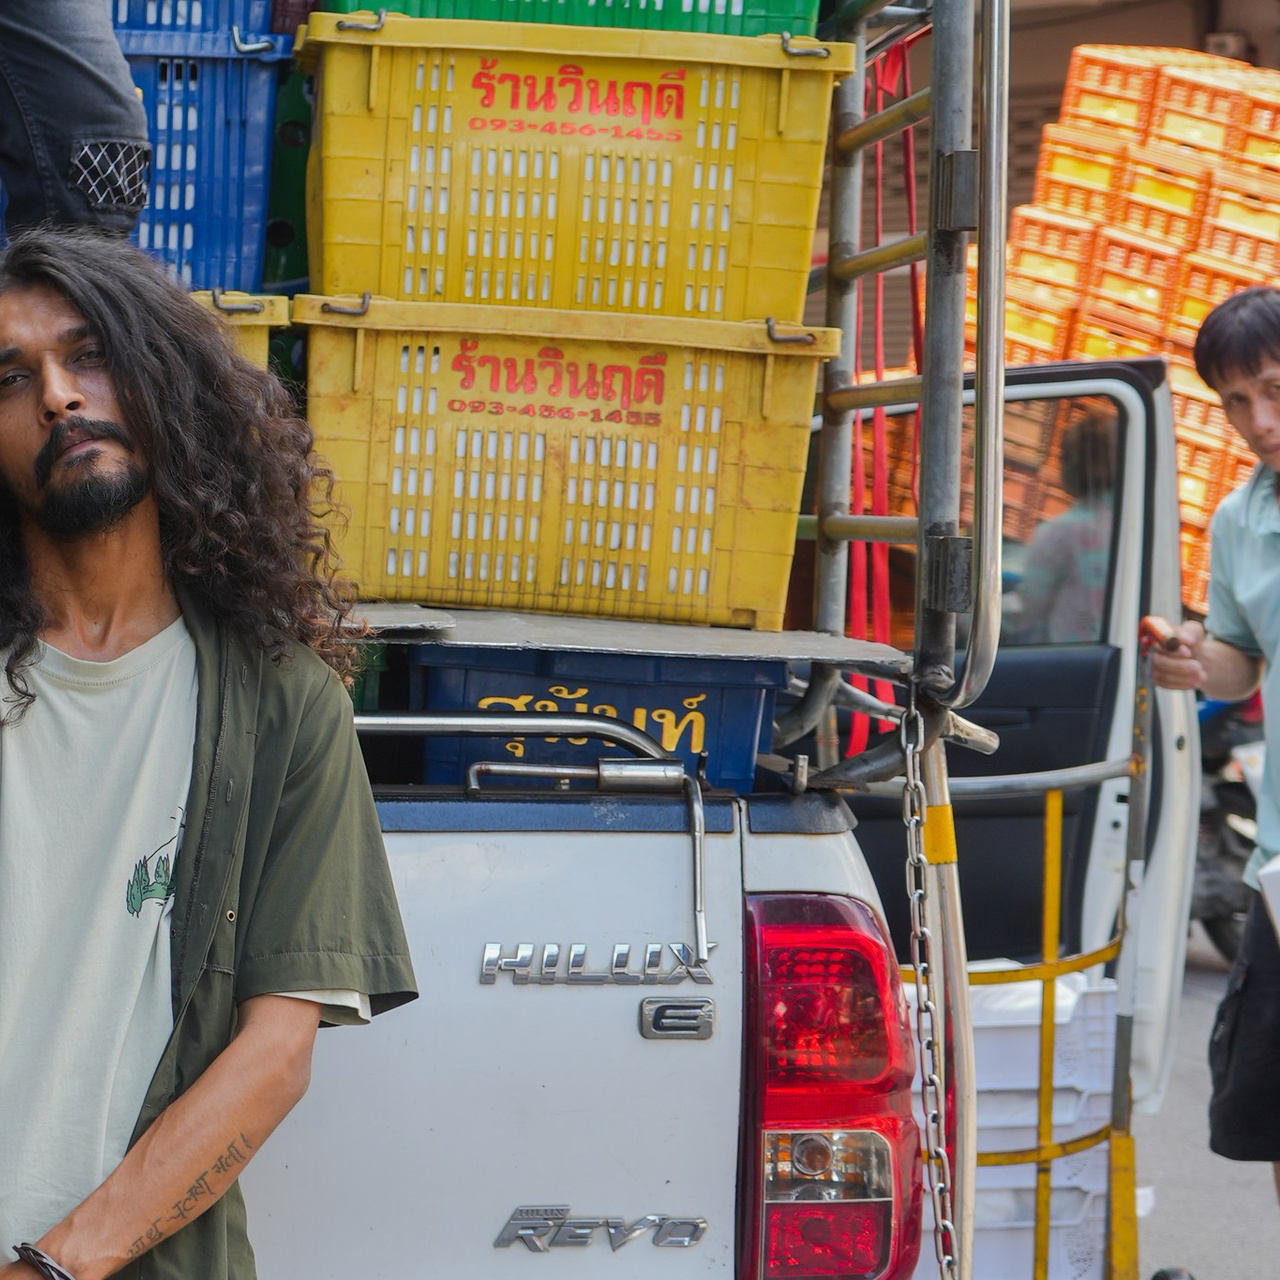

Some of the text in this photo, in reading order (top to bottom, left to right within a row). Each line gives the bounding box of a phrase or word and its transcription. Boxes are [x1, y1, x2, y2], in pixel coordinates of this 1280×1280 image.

[471, 56, 687, 126] ร้านวินฤดี
[468, 116, 683, 143] 093-456-1455
[450, 338, 667, 410] ร้านวินฤดี
[446, 397, 663, 428] 093-456-1455
[479, 941, 719, 985] HILUX
